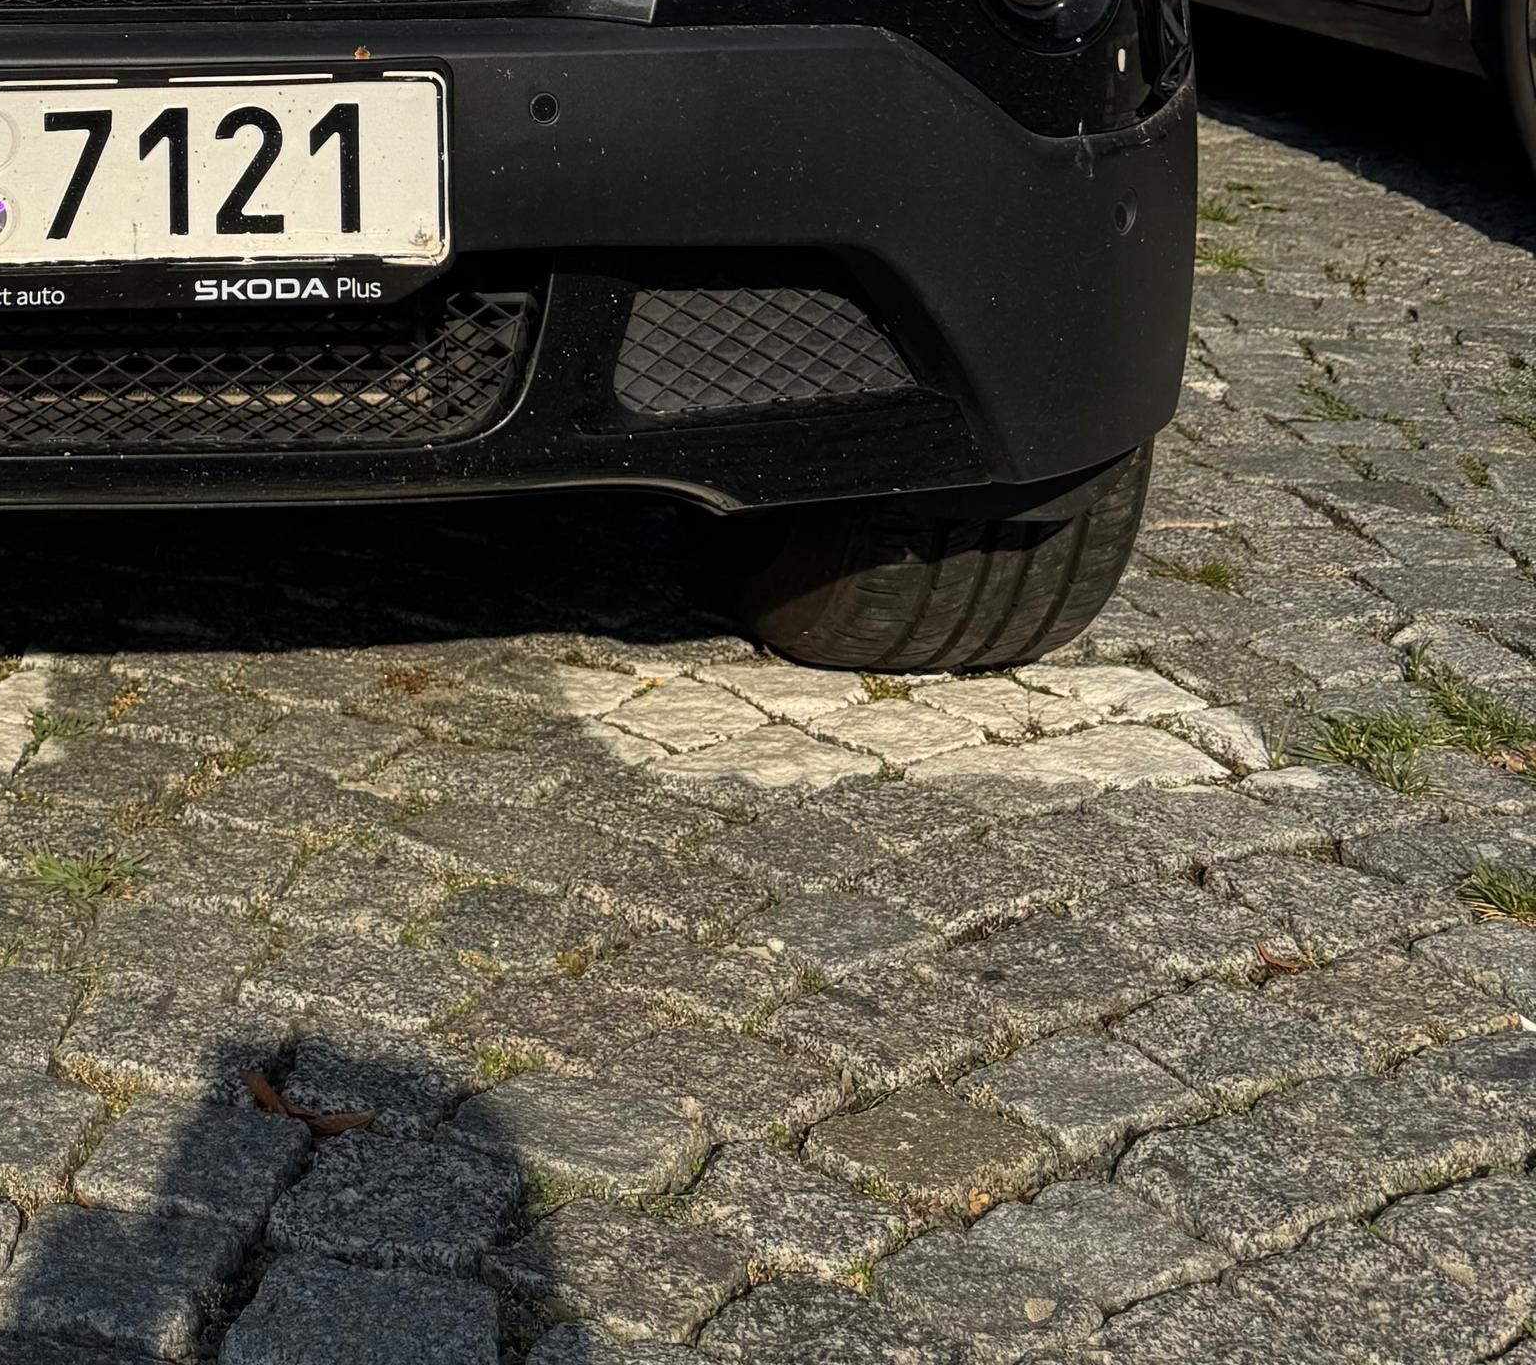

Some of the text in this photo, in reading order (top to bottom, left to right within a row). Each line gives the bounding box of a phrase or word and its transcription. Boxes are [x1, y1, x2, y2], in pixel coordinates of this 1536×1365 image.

[44, 103, 361, 240] 7121
[16, 287, 65, 306] auto
[337, 277, 382, 299] Plus
